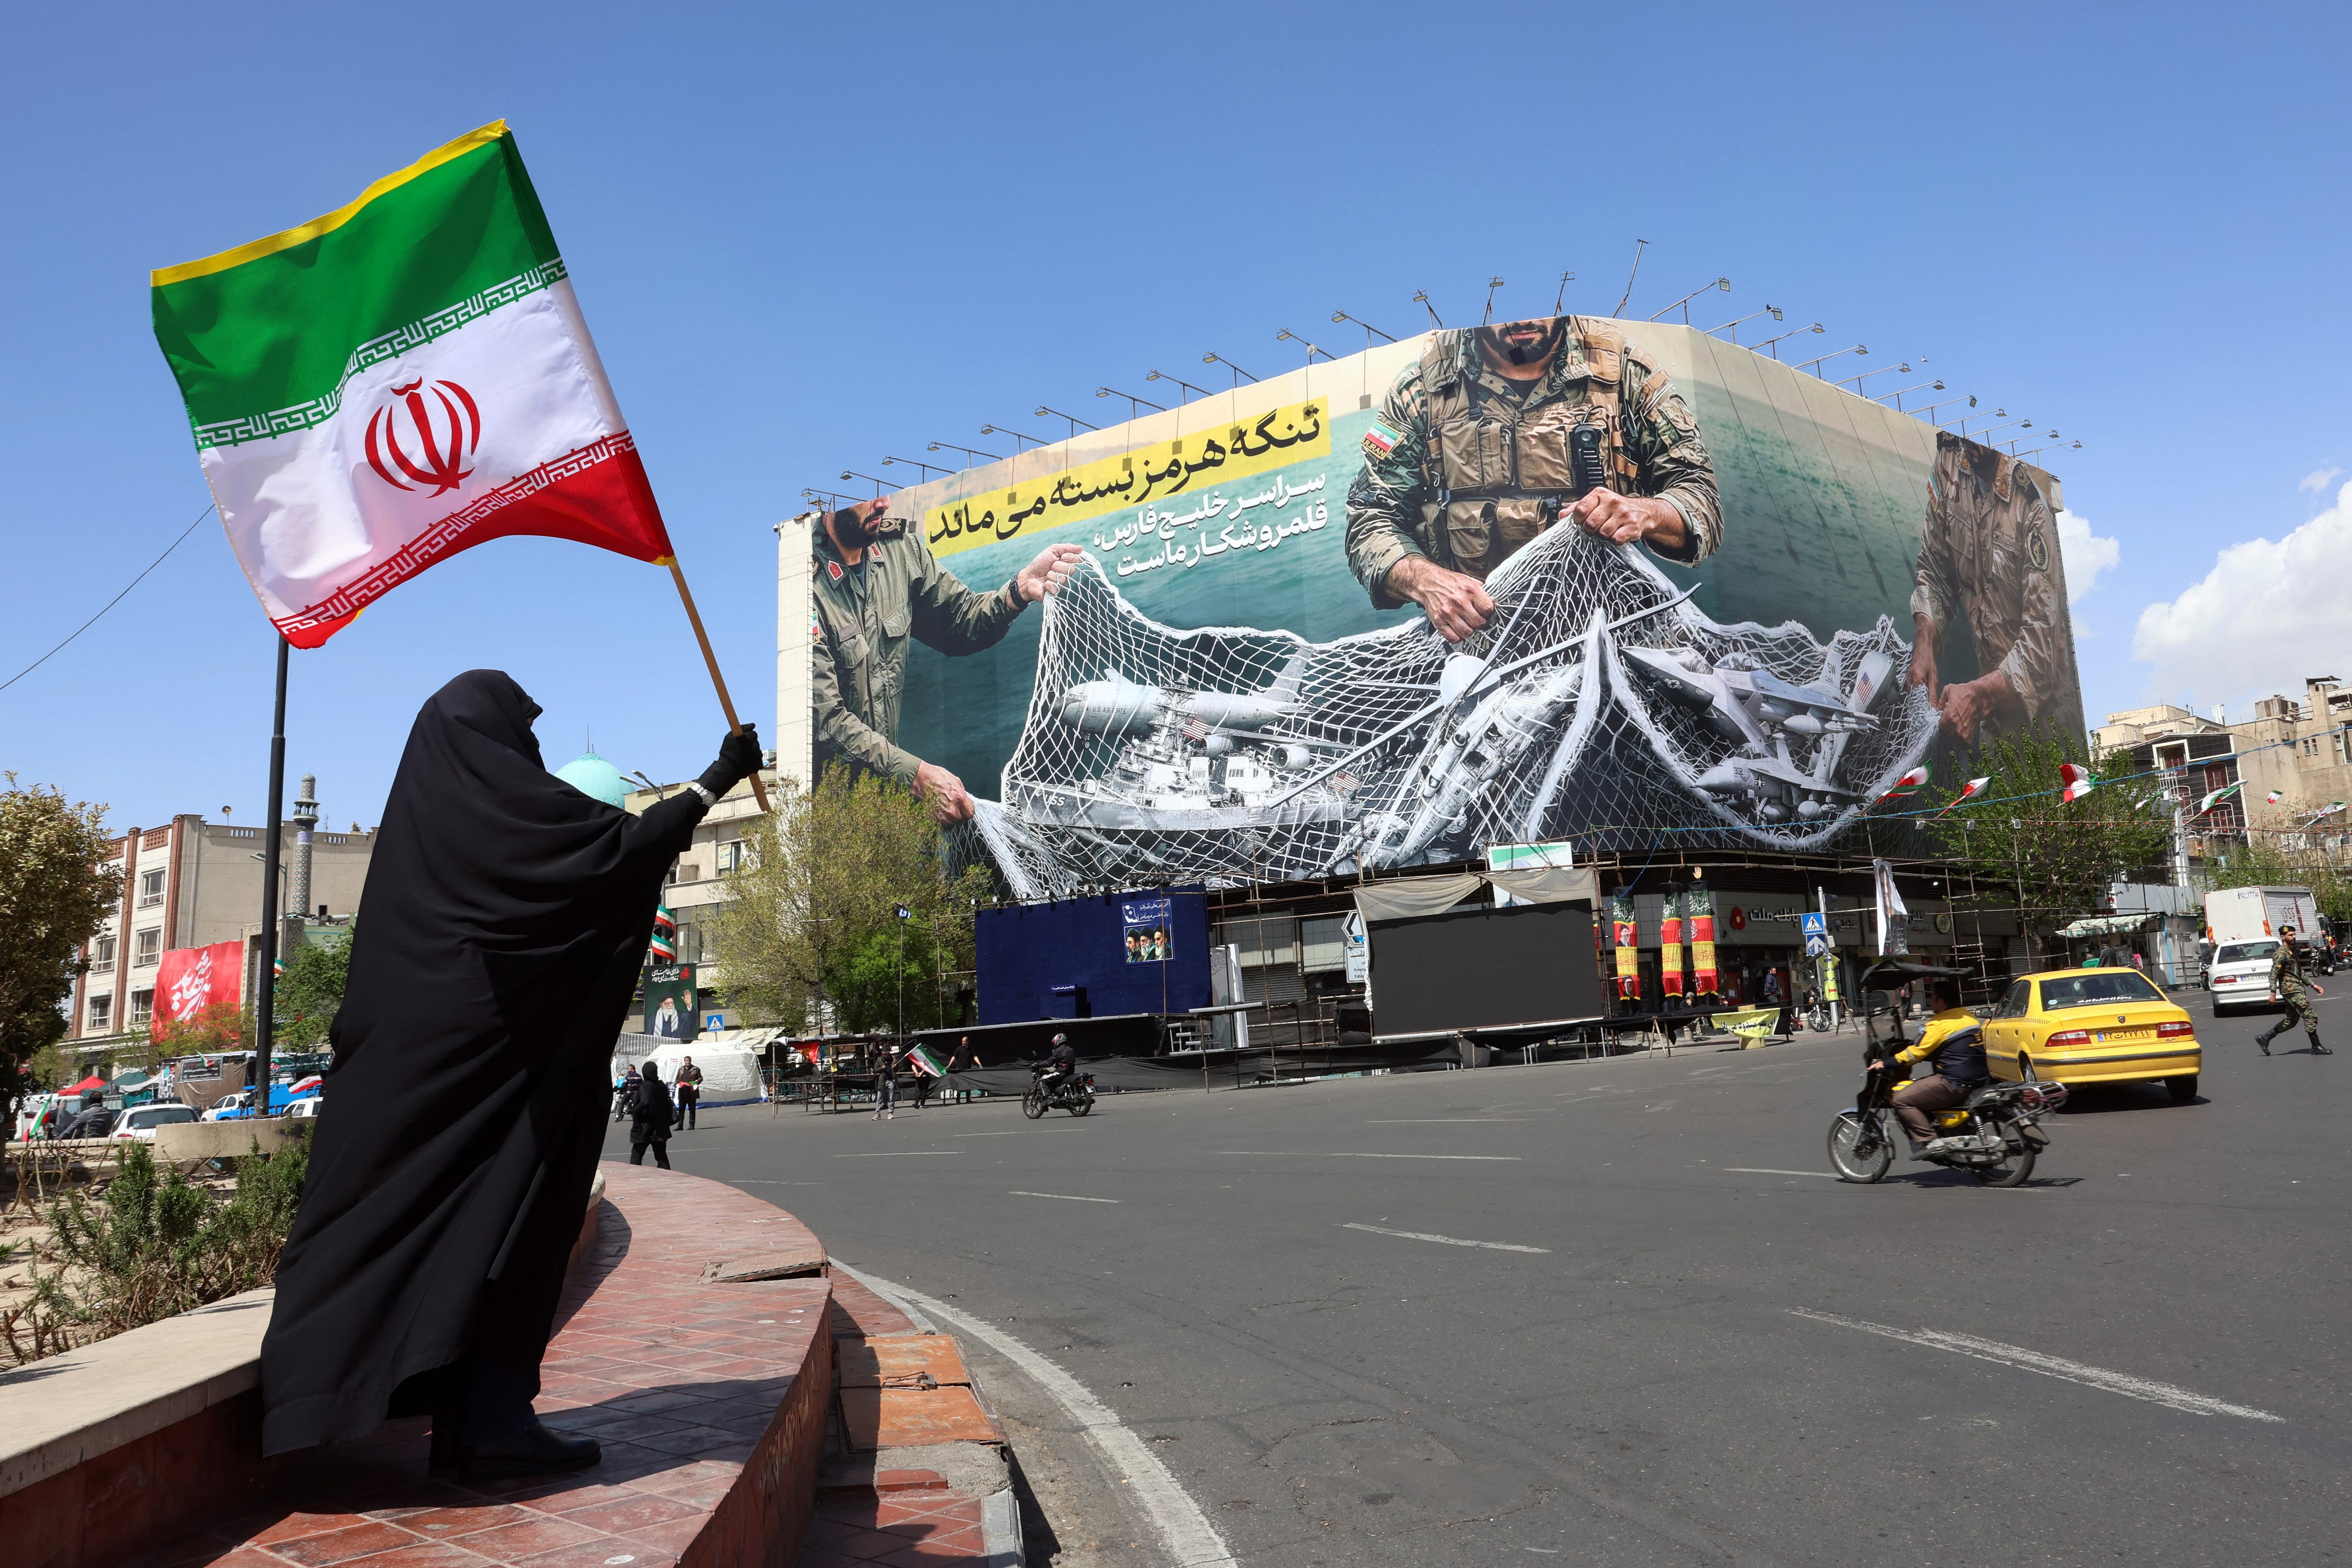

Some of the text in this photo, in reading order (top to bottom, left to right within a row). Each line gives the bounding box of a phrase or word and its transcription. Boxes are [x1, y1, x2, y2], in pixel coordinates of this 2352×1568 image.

[1231, 407, 1320, 457] تنگه
[1050, 470, 1135, 507] بسته
[1133, 438, 1226, 503] هرمز
[1158, 490, 1230, 540] خلیج
[1227, 472, 1327, 520] سراسر
[1117, 498, 1328, 577] قلمرو شکار ماست
[1733, 767, 1743, 775] 302
[1045, 794, 1065, 806] USS
[1750, 907, 1773, 922] ملت
